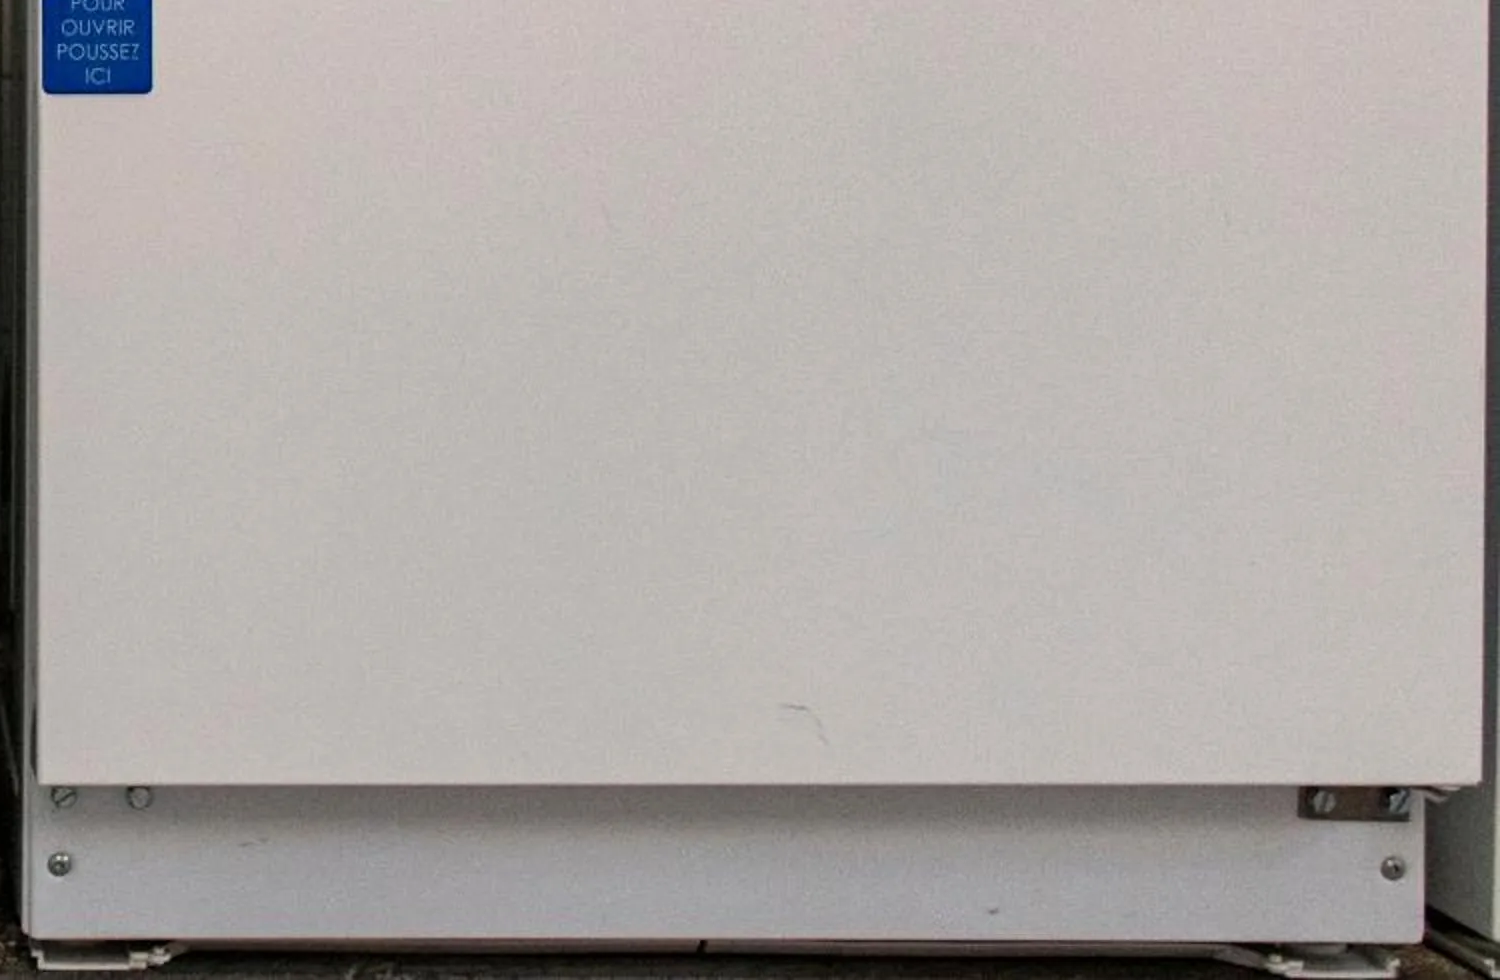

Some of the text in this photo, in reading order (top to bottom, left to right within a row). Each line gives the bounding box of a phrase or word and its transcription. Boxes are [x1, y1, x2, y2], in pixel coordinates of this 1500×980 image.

[61, 18, 135, 37] OUVRIR
[56, 43, 140, 61] POUSSEZ
[85, 67, 112, 85] ICI
